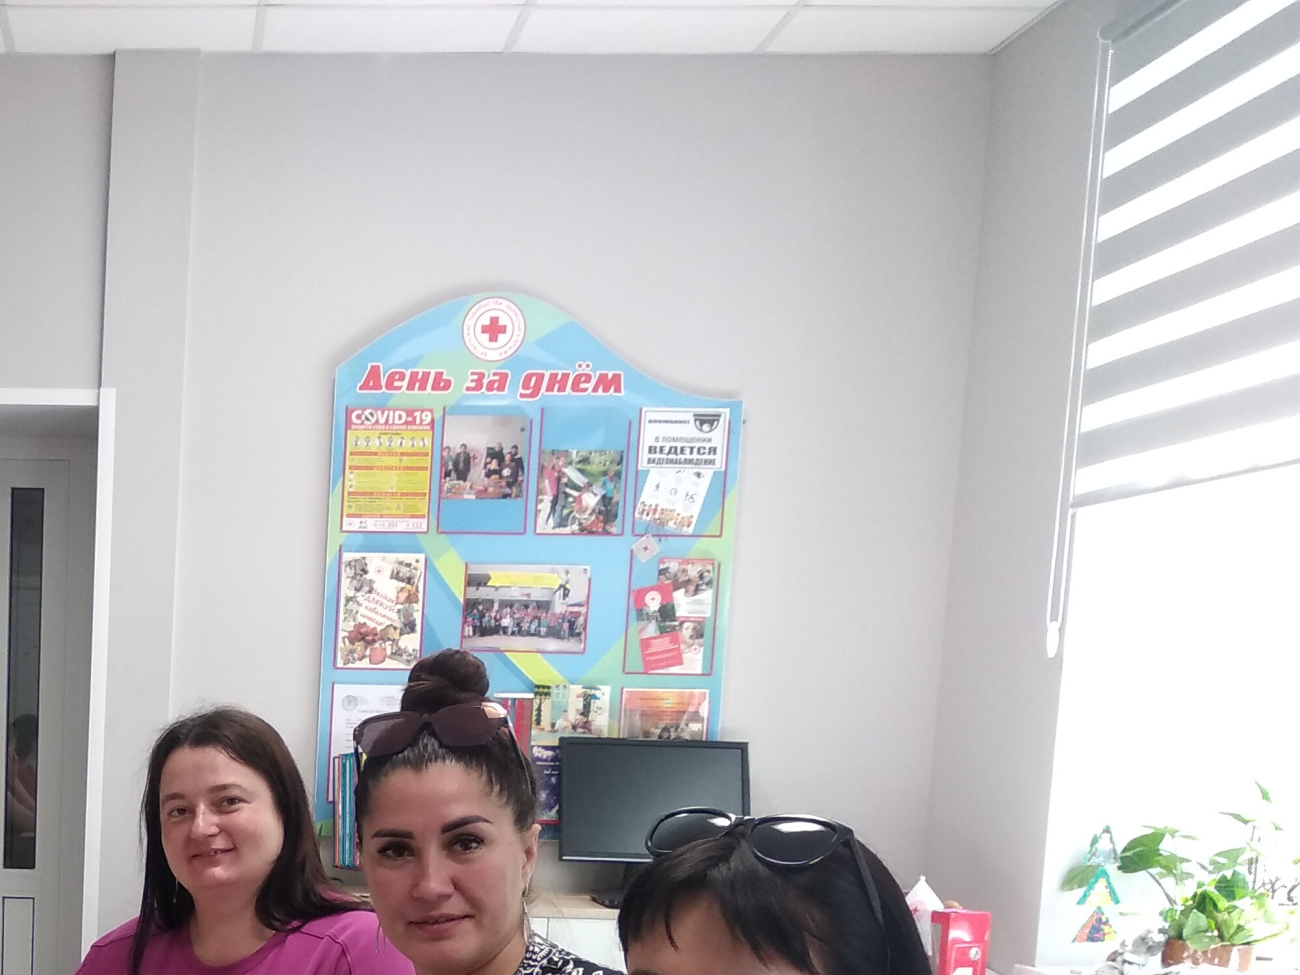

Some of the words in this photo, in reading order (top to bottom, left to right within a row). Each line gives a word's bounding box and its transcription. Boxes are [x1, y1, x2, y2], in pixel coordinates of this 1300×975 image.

[358, 364, 452, 393] День
[465, 370, 509, 393] за
[518, 362, 624, 399] днём
[351, 408, 432, 425] COVID-19
[647, 445, 718, 456] ВЕДЕТСЯ
[647, 456, 717, 467] ВИДЕОНАБЛЮДЕНИЕ
